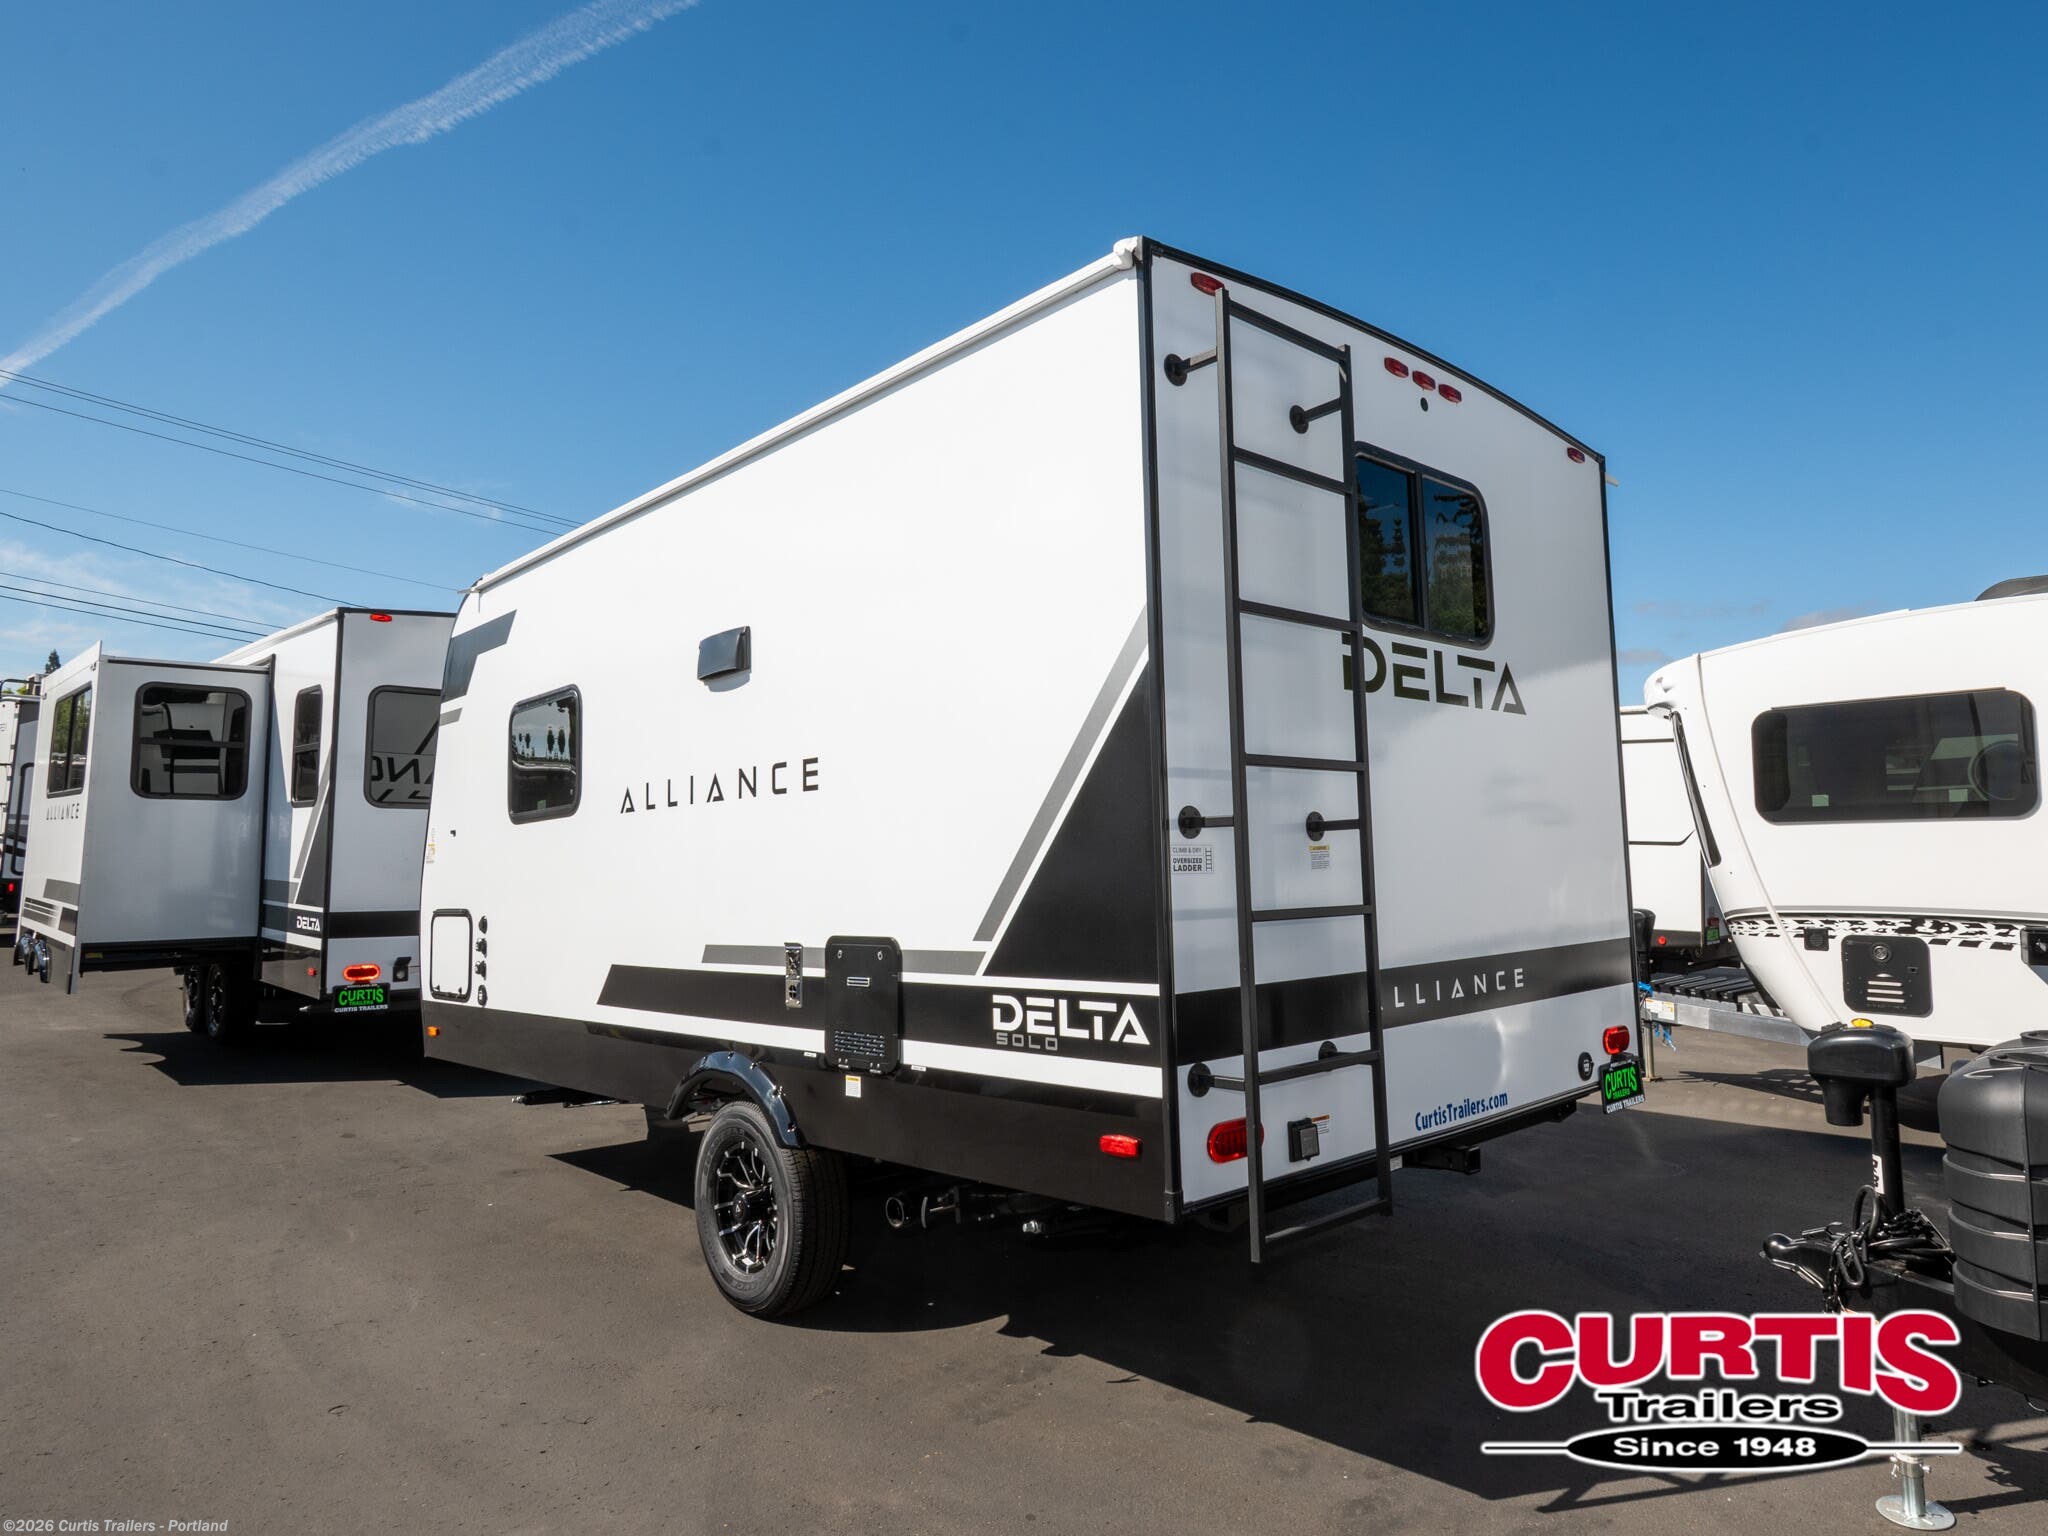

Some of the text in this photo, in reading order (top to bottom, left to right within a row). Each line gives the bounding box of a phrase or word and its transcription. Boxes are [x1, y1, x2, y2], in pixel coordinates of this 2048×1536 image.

[1341, 632, 1527, 715] DELTA
[620, 757, 819, 814] ALLIANCE
[296, 915, 321, 931] DELTA
[339, 988, 384, 1006] CURTIS
[1380, 968, 1525, 1012] LLIANCE
[992, 994, 1151, 1046] DELTA
[996, 1032, 1059, 1051] SOLO
[1605, 1066, 1638, 1100] CURTIS
[1414, 1092, 1508, 1132] CurtisTrailers.com
[1606, 1094, 1645, 1114] CURTIS TRAILERS
